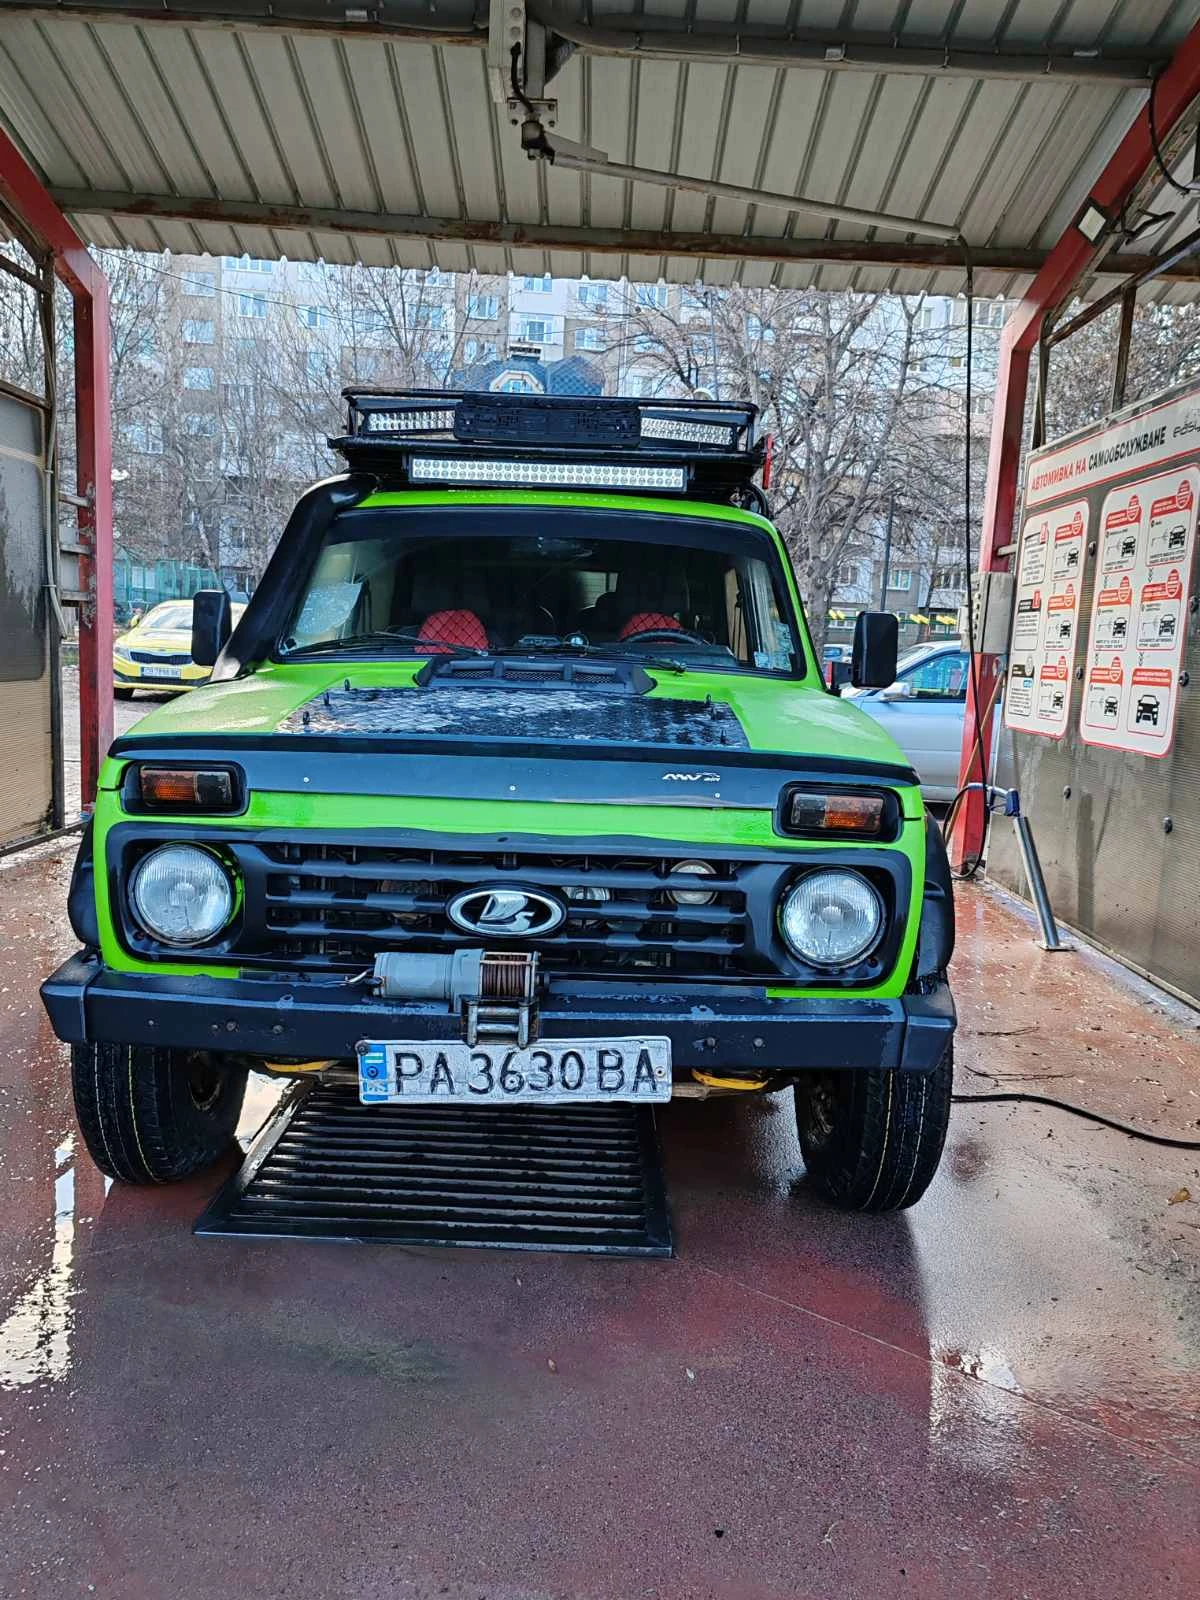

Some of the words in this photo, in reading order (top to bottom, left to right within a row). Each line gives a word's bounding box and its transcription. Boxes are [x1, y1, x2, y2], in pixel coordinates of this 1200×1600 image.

[1032, 463, 1073, 490] АВТОМИВКА
[1075, 457, 1086, 474] НА
[1088, 425, 1167, 471] САМООБСЛУЖВАНЕ
[467, 1050, 585, 1095] 3630
